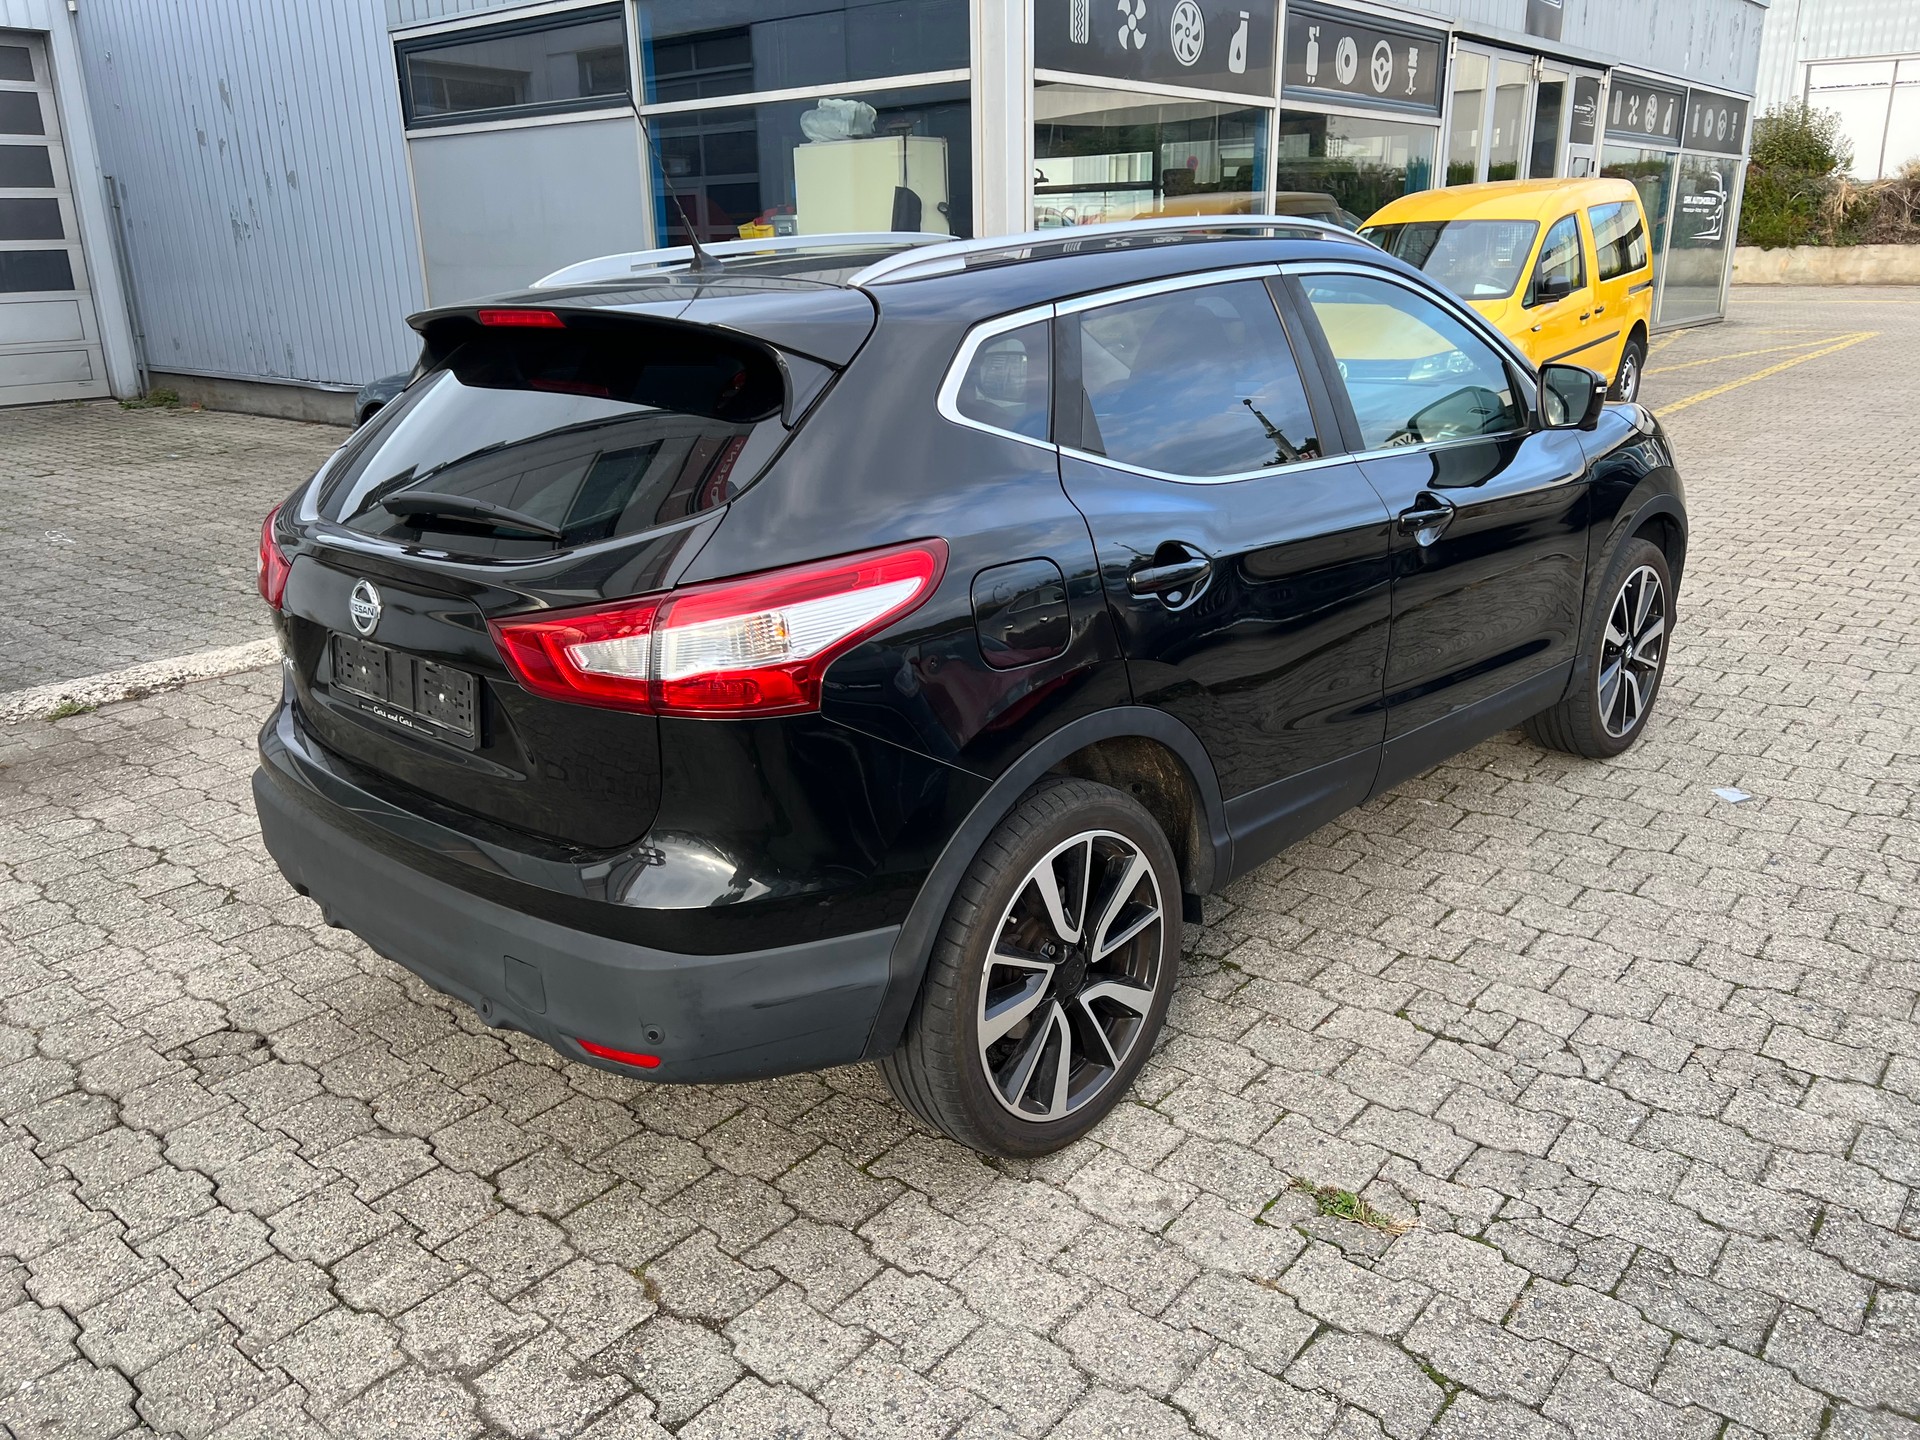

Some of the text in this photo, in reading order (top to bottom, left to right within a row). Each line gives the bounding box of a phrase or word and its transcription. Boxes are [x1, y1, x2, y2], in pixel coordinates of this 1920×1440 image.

[351, 602, 375, 616] SSAN
[373, 705, 387, 718] Cars
[387, 713, 399, 722] and
[399, 716, 413, 728] Cars
